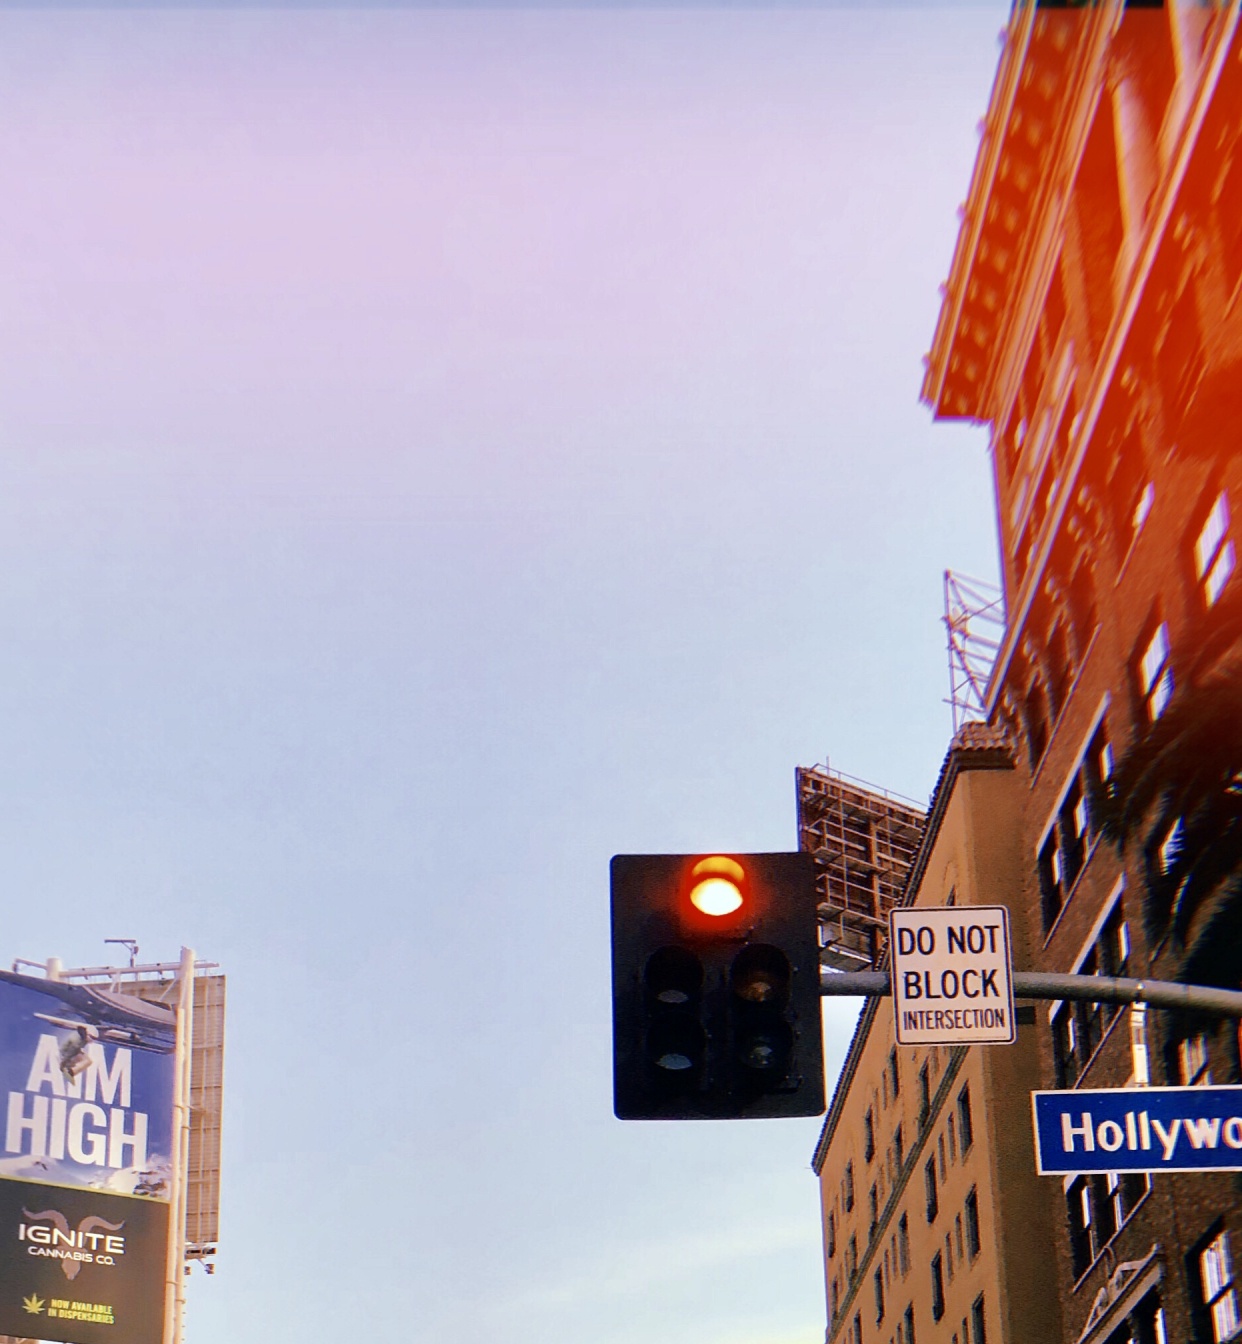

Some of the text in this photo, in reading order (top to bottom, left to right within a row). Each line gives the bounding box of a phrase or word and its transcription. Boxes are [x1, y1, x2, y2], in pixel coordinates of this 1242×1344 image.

[898, 925, 999, 955] DO NOT
[904, 969, 1000, 999] BLOCK
[903, 1008, 1005, 1030] INTERSECTION
[5, 1091, 148, 1171] HIGH
[1061, 1110, 1242, 1161] Hollywo
[18, 1223, 125, 1254] IGNITE
[28, 1246, 116, 1265] CANNABIS CO.
[48, 1308, 115, 1324] IN DISPENSARIES
[51, 1299, 113, 1315] NOW AVAILABLE
